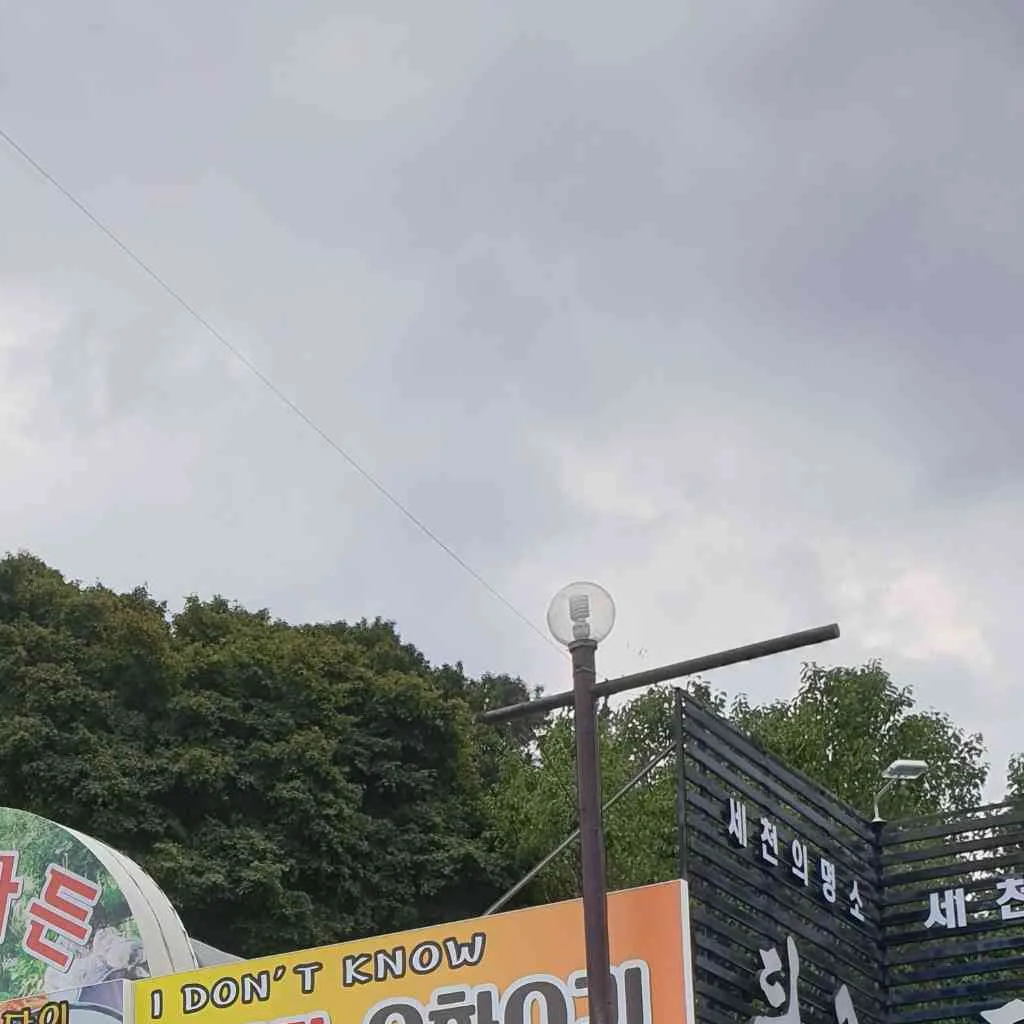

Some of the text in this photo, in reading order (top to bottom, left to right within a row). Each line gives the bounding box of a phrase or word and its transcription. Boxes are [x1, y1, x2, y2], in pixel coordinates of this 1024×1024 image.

[150, 932, 486, 1018] I DON'T KNOW
